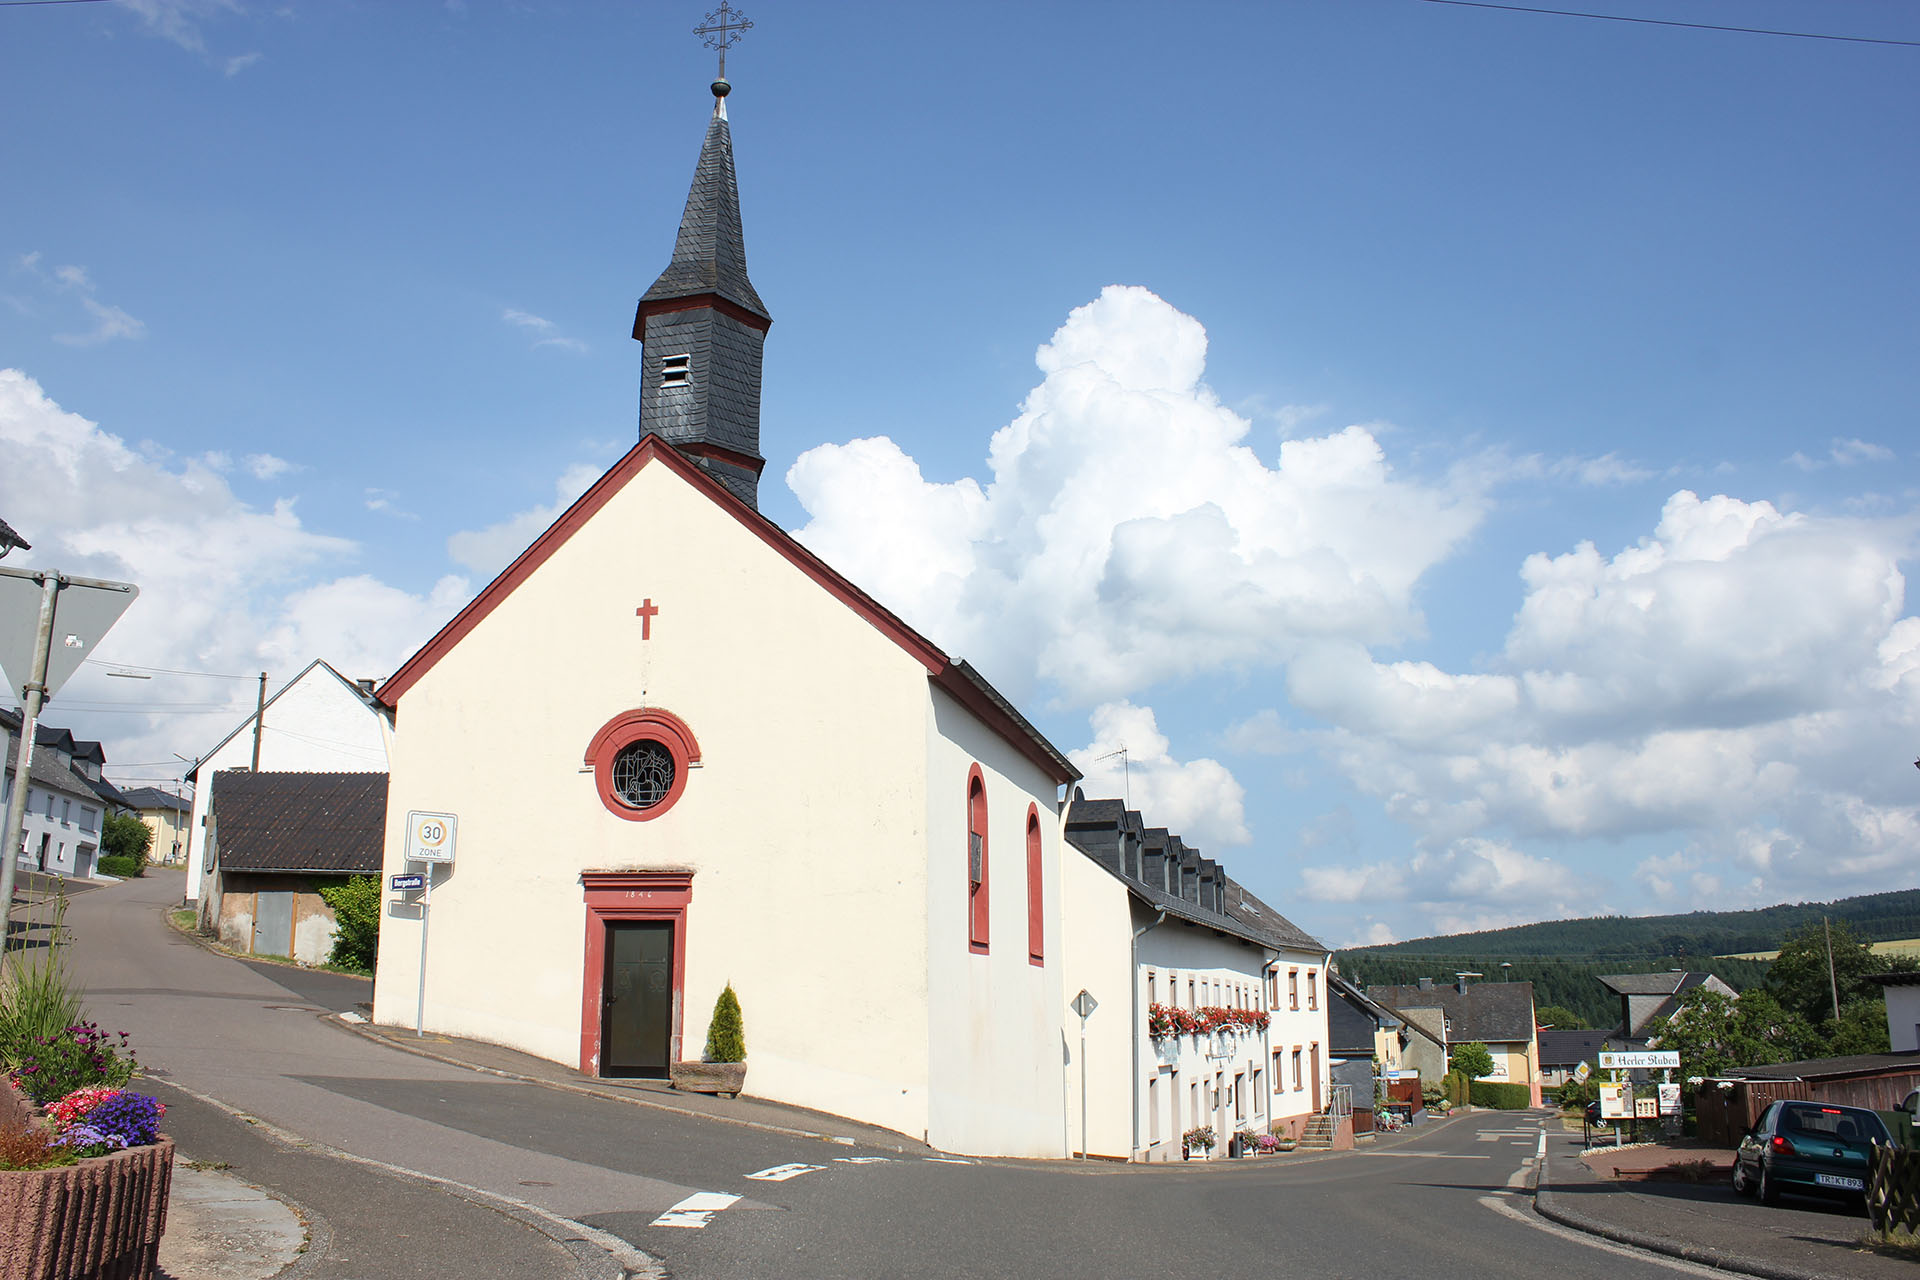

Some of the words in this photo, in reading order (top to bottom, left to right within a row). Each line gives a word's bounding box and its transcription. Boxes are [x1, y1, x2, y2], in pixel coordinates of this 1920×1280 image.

[423, 825, 441, 840] 30
[419, 848, 442, 857] ZONE
[1648, 1054, 1678, 1065] Stuben
